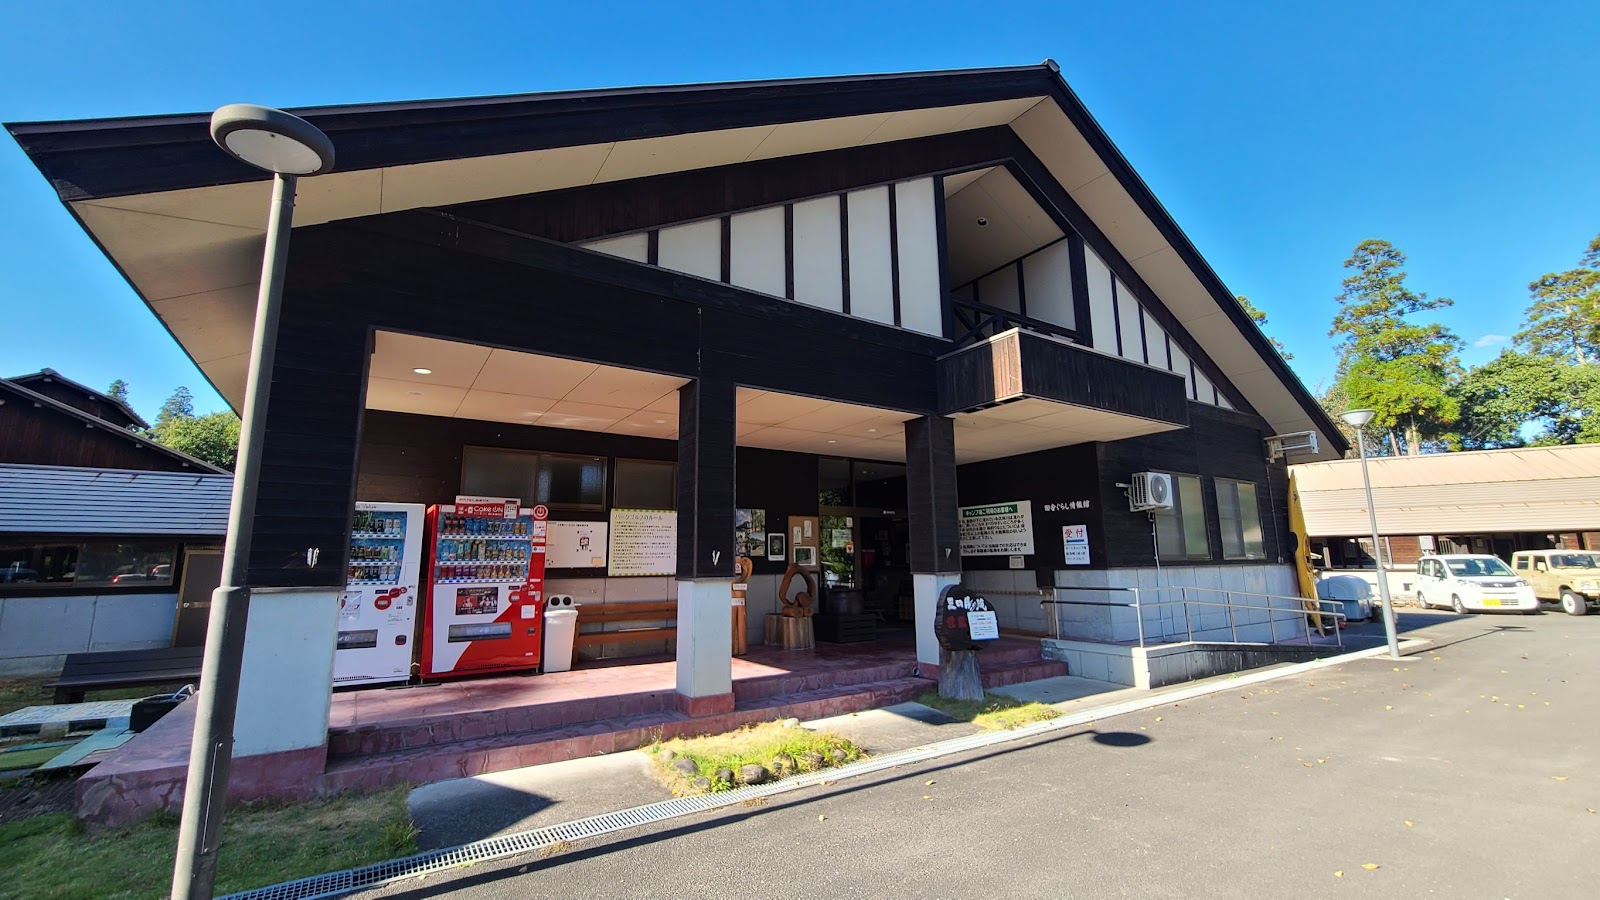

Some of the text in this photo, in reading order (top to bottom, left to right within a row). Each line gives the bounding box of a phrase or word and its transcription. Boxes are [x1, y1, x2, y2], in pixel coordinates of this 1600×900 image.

[1044, 500, 1090, 512] 田舎ぐらし情報館
[1065, 528, 1083, 538] 受付
